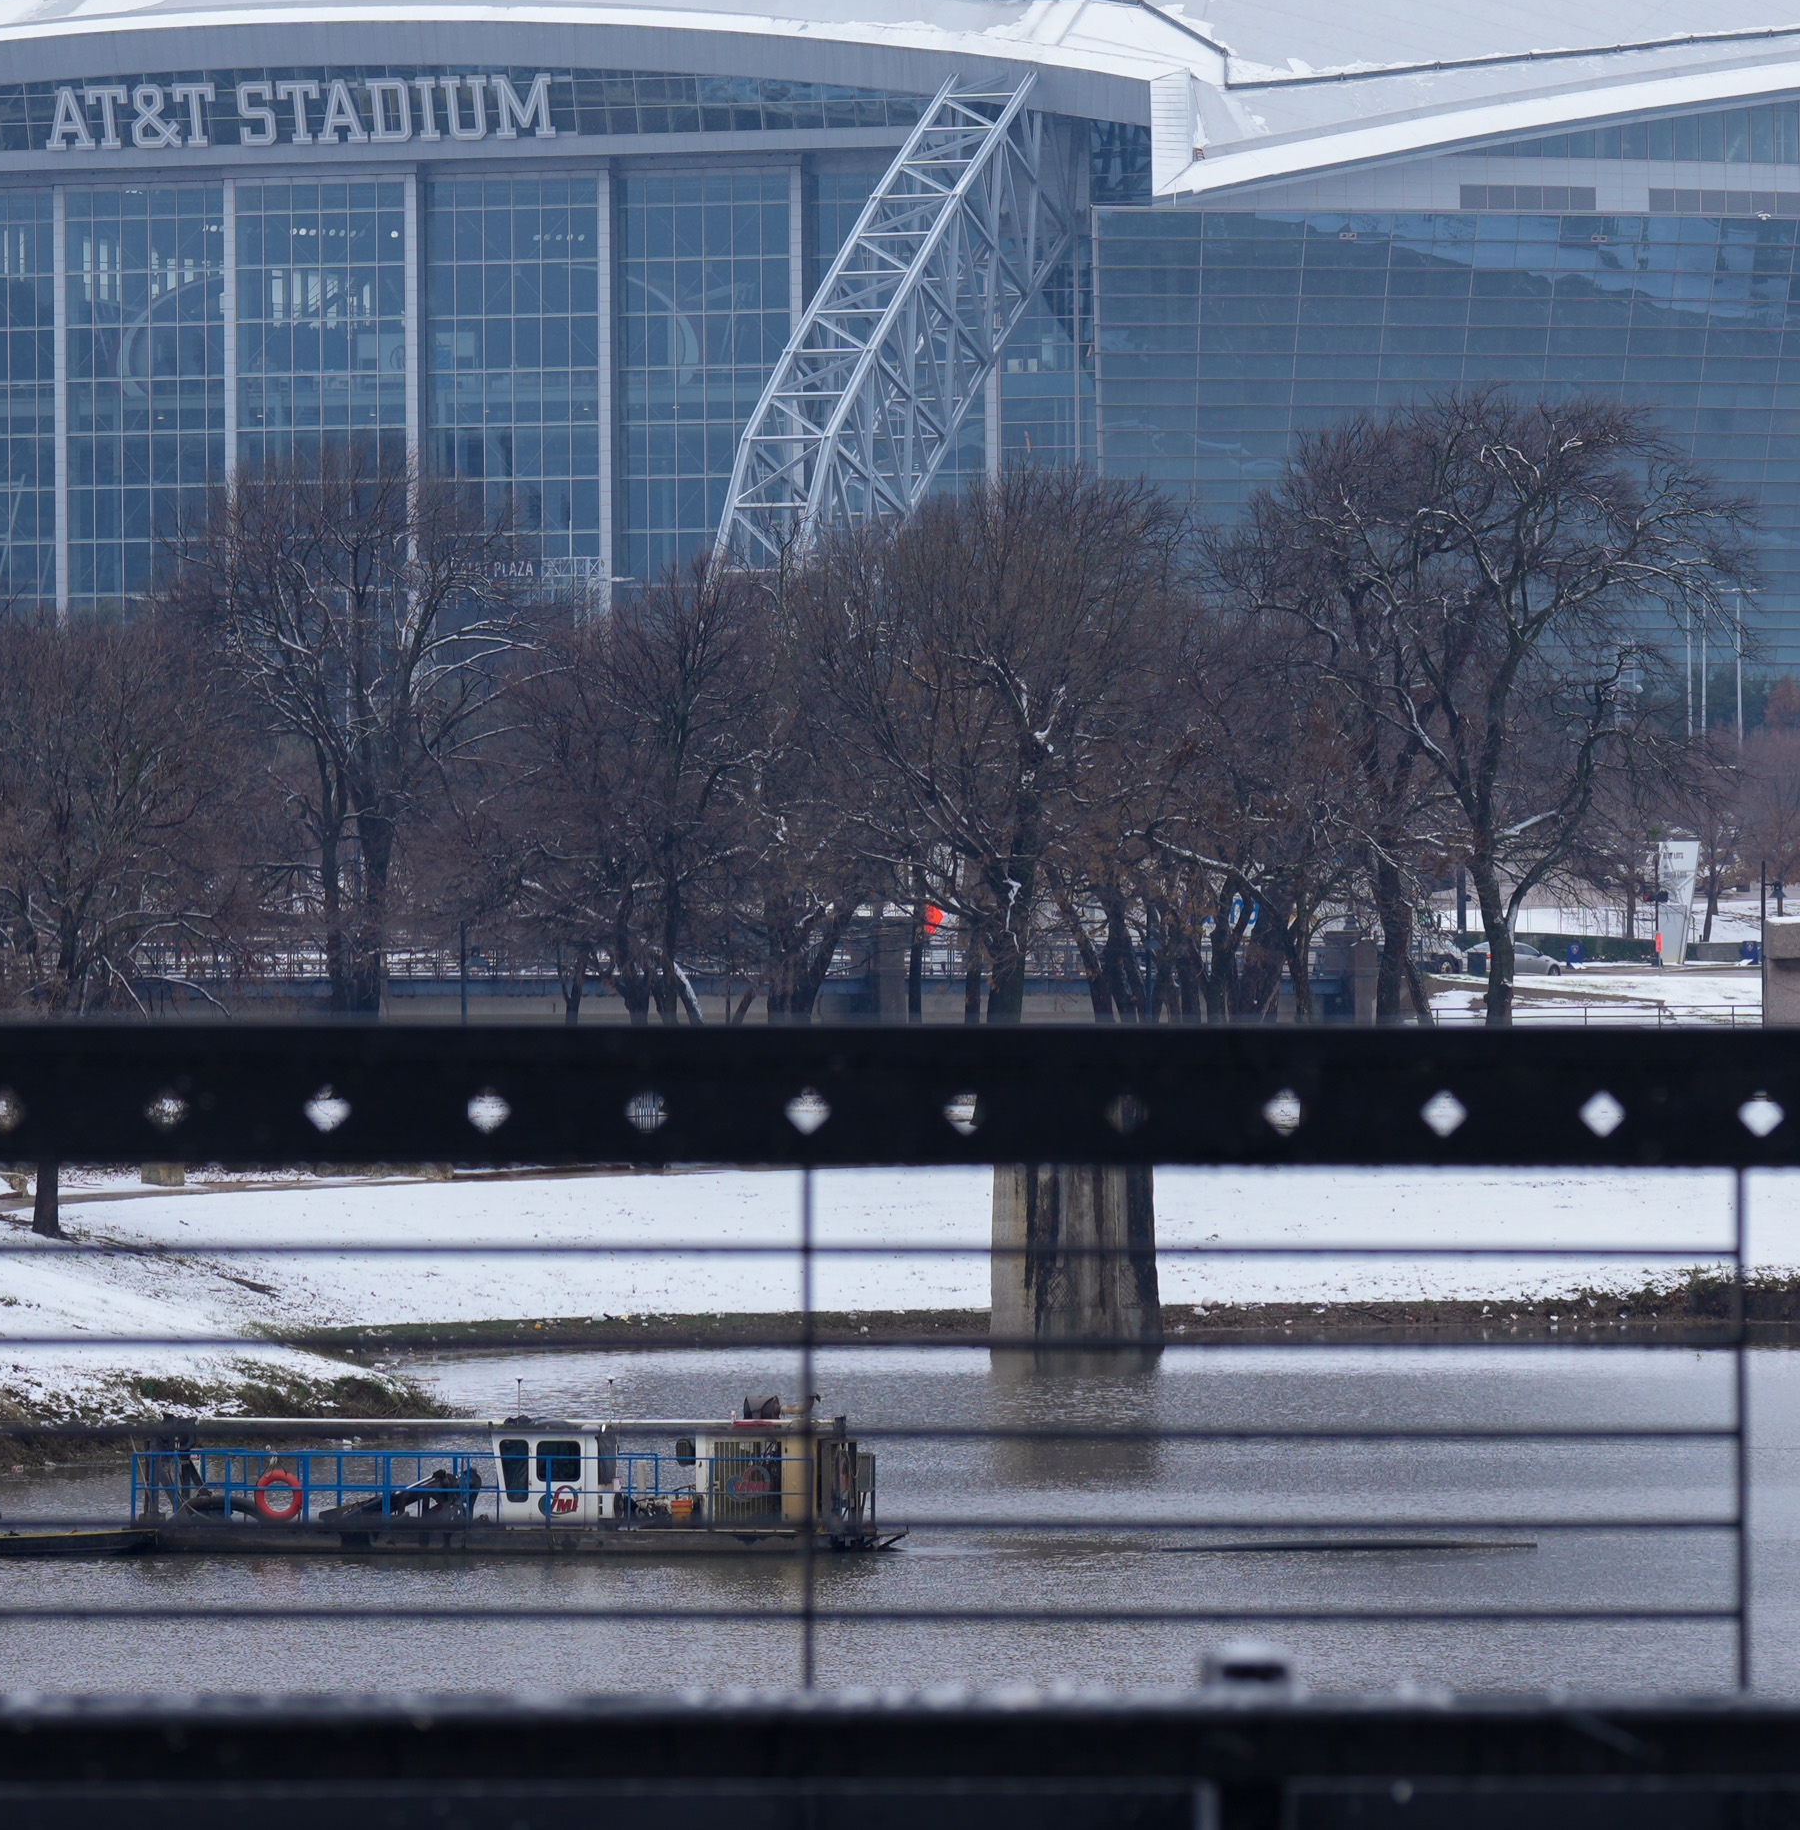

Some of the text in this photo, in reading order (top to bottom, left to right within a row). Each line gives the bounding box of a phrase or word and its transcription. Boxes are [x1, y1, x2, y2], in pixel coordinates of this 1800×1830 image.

[45, 72, 558, 151] AT&T STADIUM
[494, 560, 534, 577] PLAZA
[734, 1481, 770, 1493] VMI
